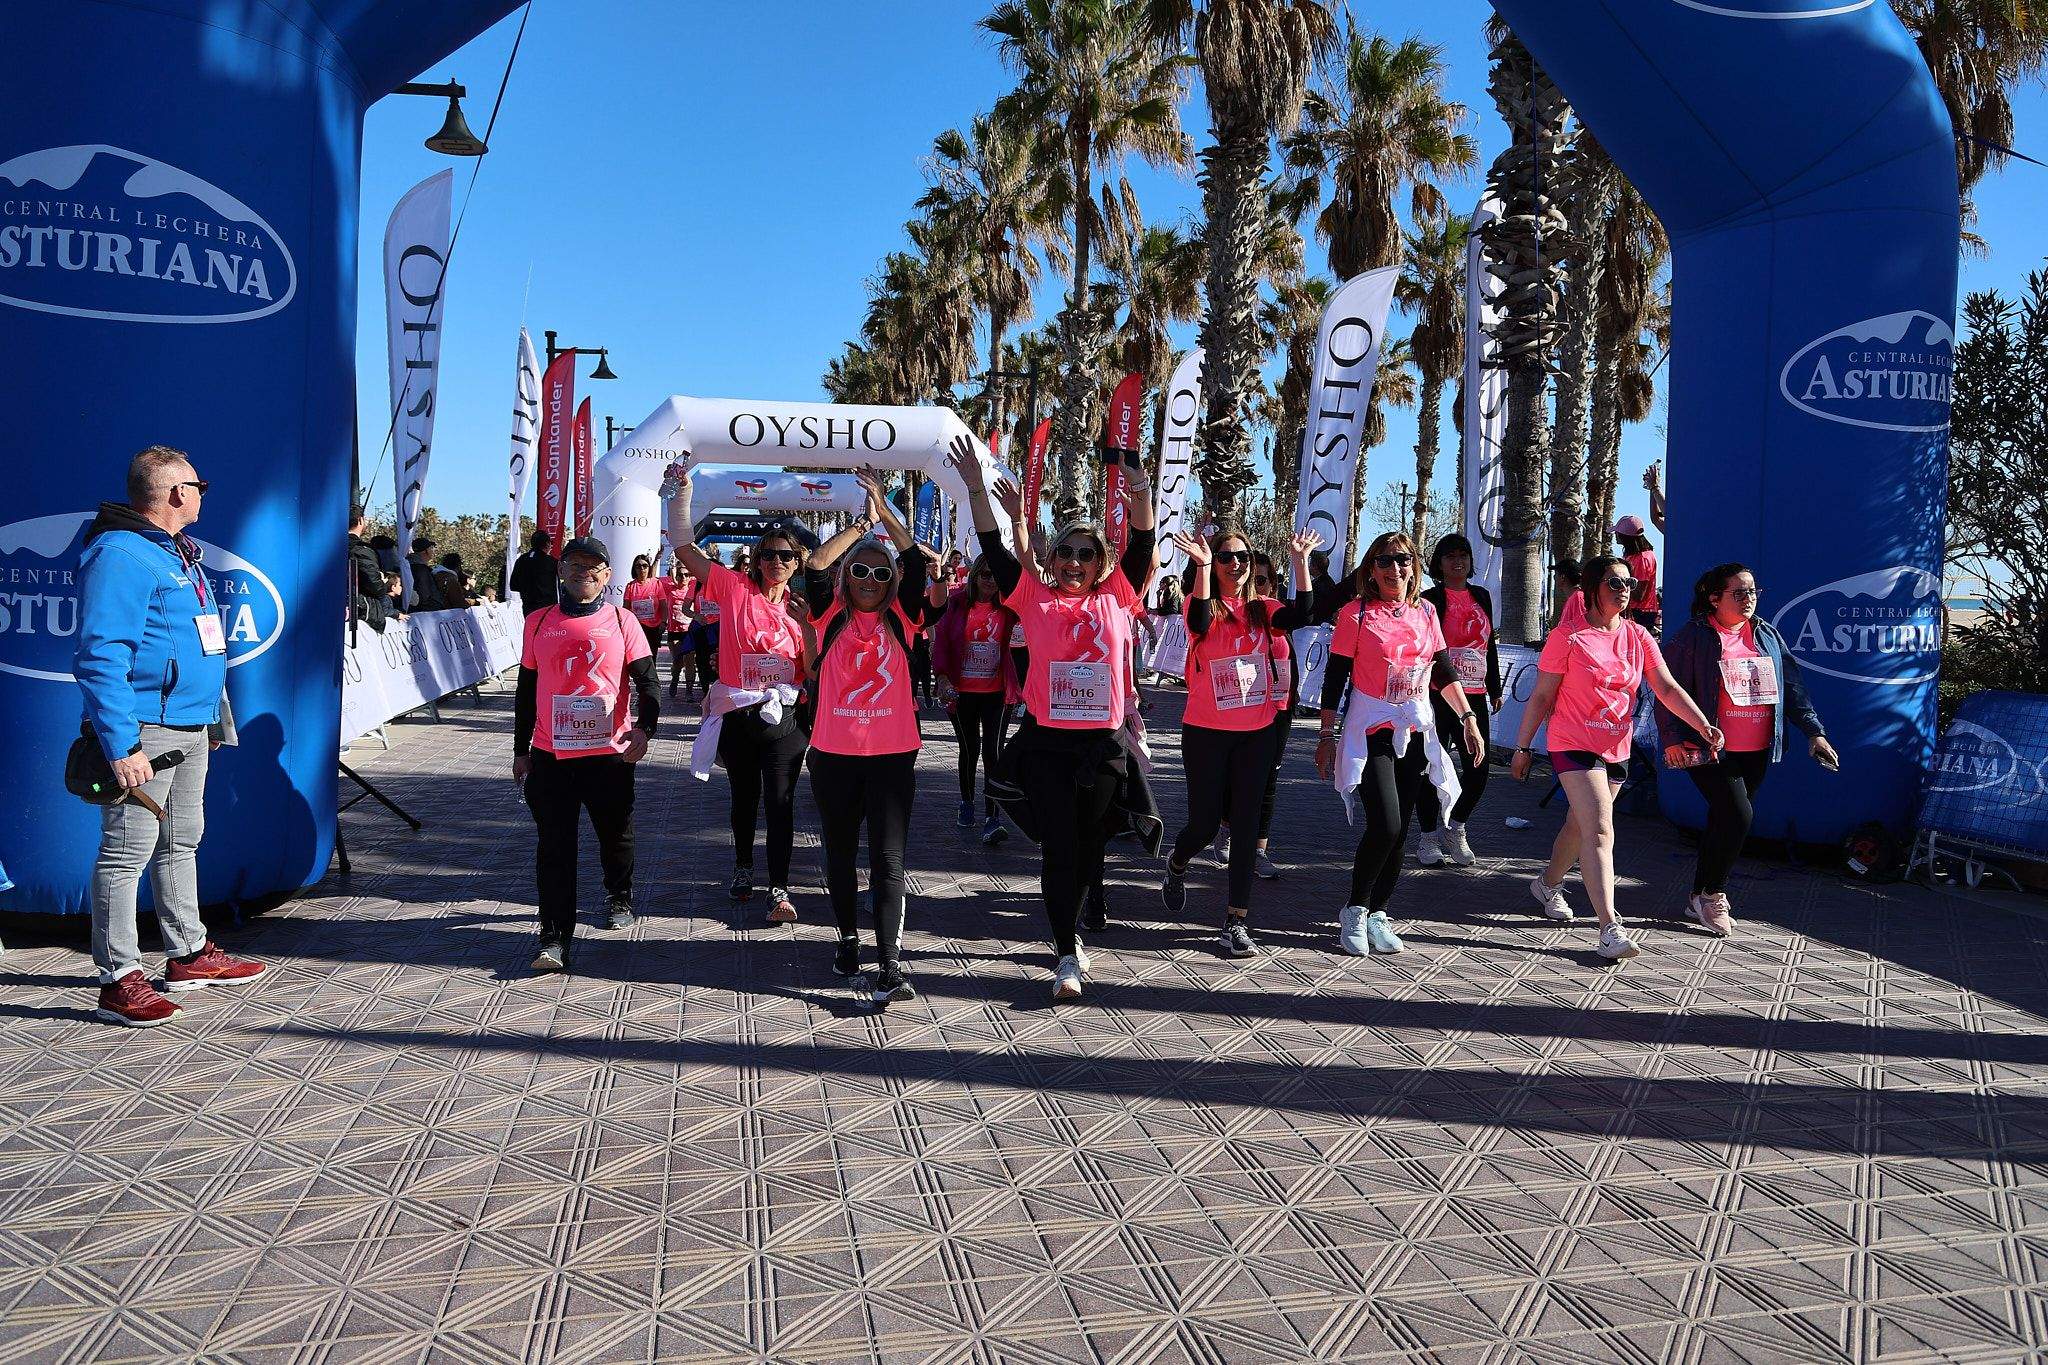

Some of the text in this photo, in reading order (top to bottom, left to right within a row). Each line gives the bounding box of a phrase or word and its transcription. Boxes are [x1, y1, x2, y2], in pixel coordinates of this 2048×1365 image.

[4, 200, 263, 250] CENTRAL LECHERA
[1848, 351, 1924, 364] CENTRAL
[546, 381, 563, 480] Santander
[728, 413, 897, 452] OYSHO
[1306, 316, 1373, 557] OYSHO
[624, 447, 677, 461] OYSHO
[577, 422, 586, 502] Santander
[1157, 389, 1197, 569] OYSHO
[600, 515, 648, 528] OYSHO
[714, 520, 782, 529] VOLVO
[1837, 607, 1912, 618] CENTRAL
[1462, 665, 1477, 673] 016
[760, 674, 780, 683] 016
[1234, 677, 1253, 688] 016
[1741, 678, 1760, 687] 016
[1071, 688, 1095, 699] 016
[1407, 686, 1423, 696] 016
[833, 707, 858, 717] CARRERA
[859, 709, 867, 718] DE
[867, 709, 876, 718] LA
[572, 720, 596, 729] 016
[1584, 719, 1610, 729] CARRERA
